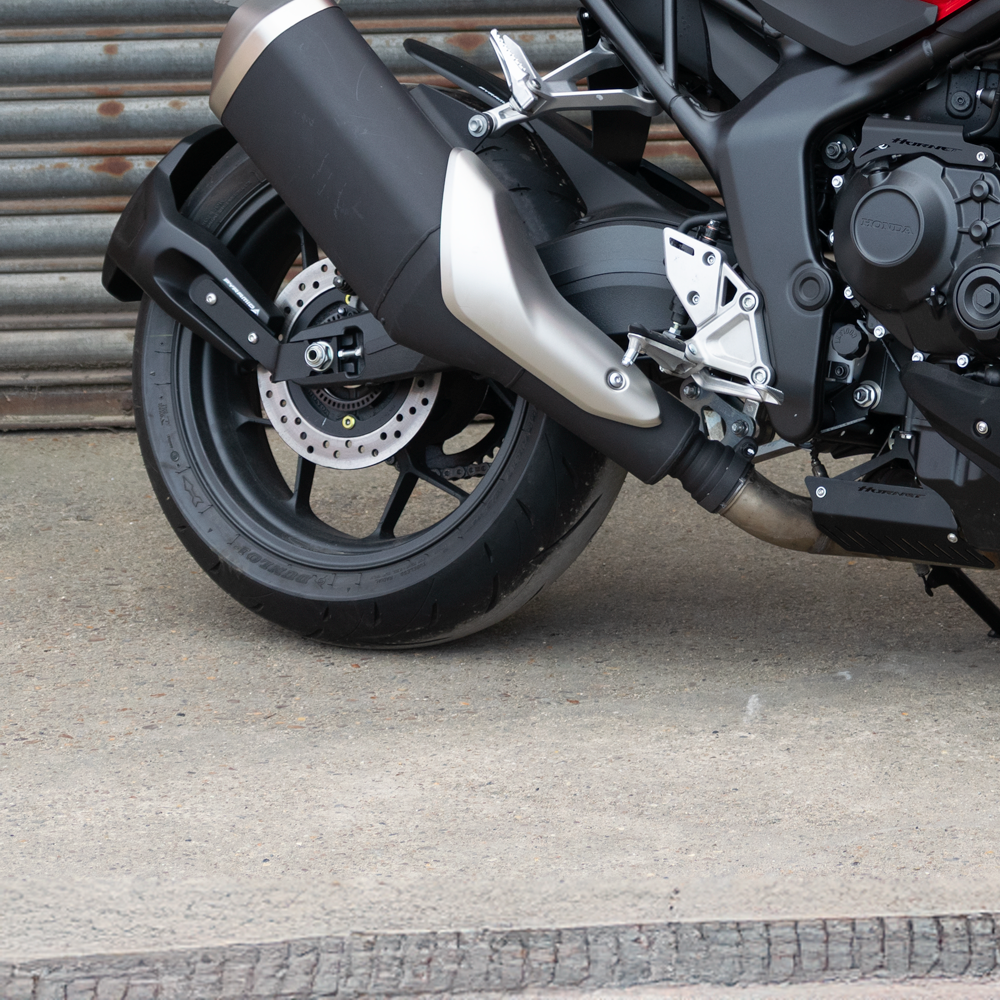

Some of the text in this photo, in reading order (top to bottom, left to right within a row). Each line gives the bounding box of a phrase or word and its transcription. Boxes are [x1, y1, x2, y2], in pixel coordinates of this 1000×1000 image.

[892, 137, 963, 152] HORNET
[860, 217, 914, 235] HONDA
[223, 277, 256, 310] PYRAMID
[857, 485, 926, 499] HORNET
[236, 544, 311, 584] DUNLOP
